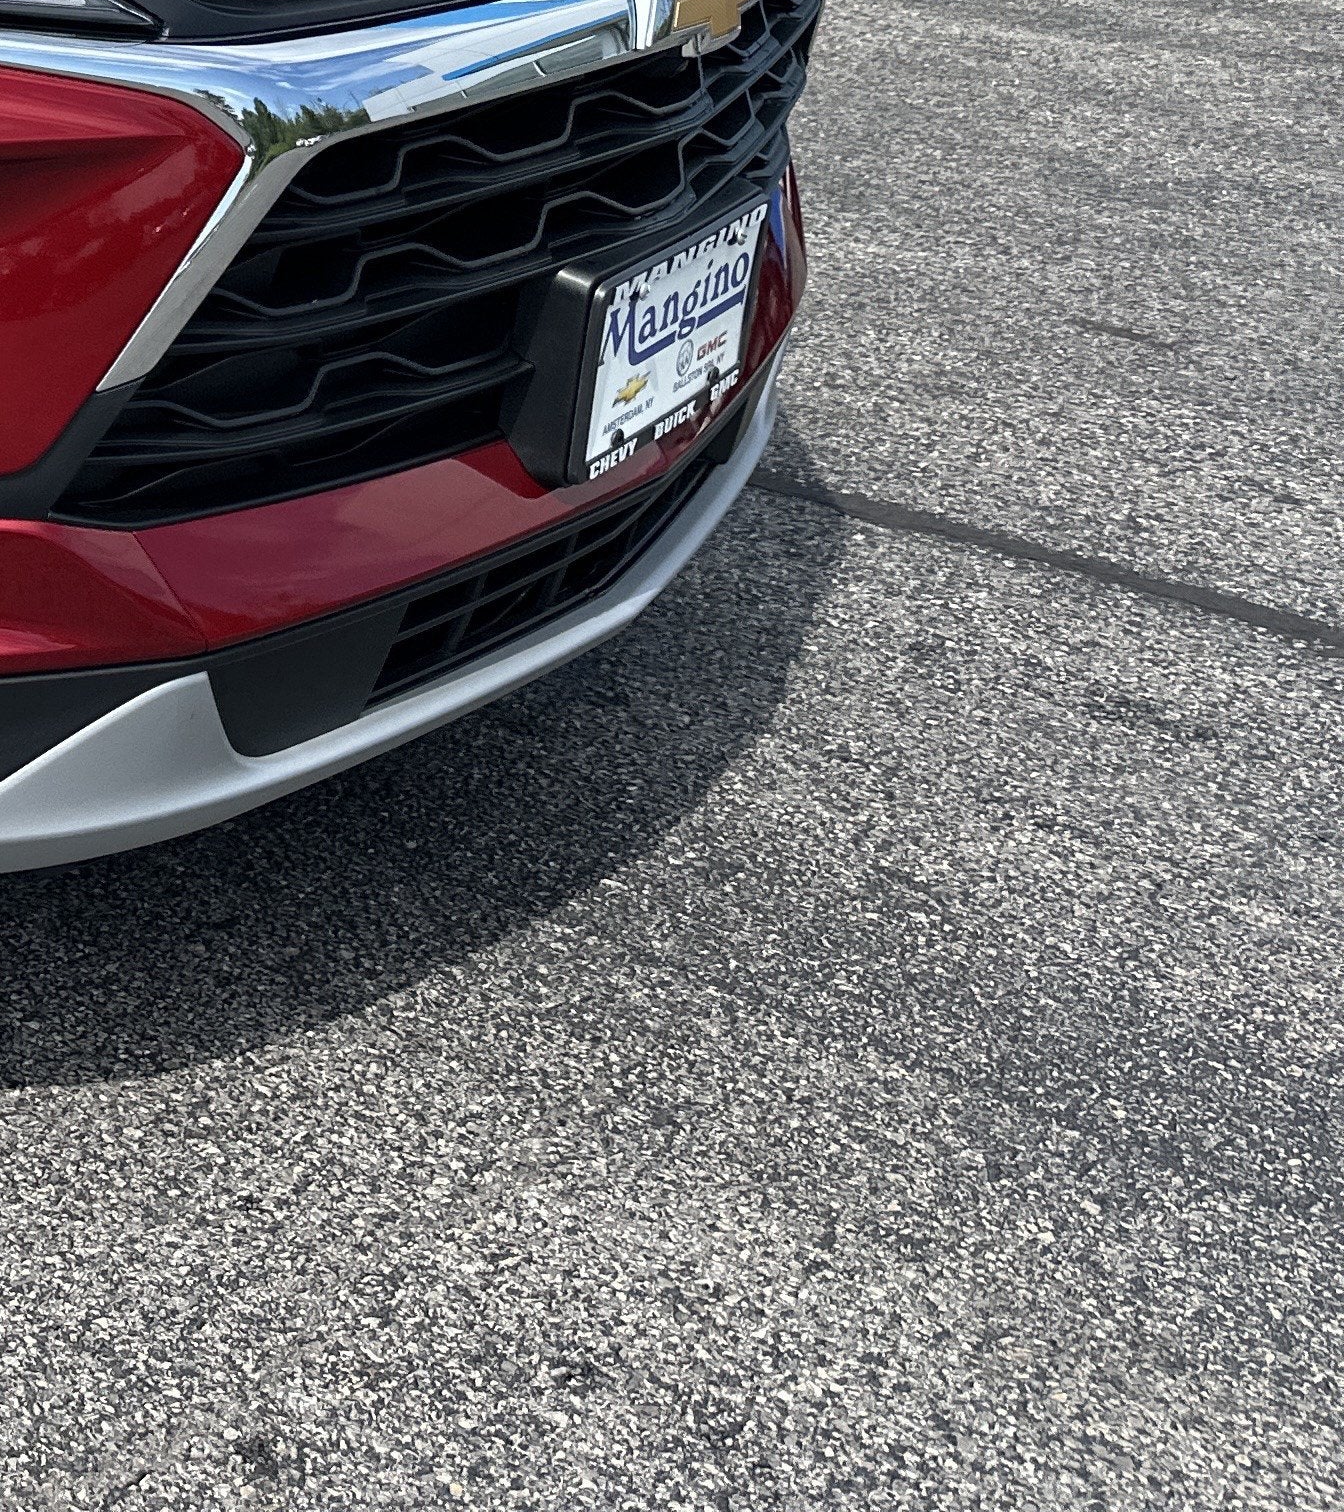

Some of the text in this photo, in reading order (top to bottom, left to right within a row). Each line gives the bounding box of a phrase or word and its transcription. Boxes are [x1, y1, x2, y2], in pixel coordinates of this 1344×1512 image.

[614, 203, 768, 306] MANGINO
[599, 252, 750, 366] Mangino
[697, 331, 727, 361] GMC
[589, 369, 740, 480] CHEVY BUICK GMC
